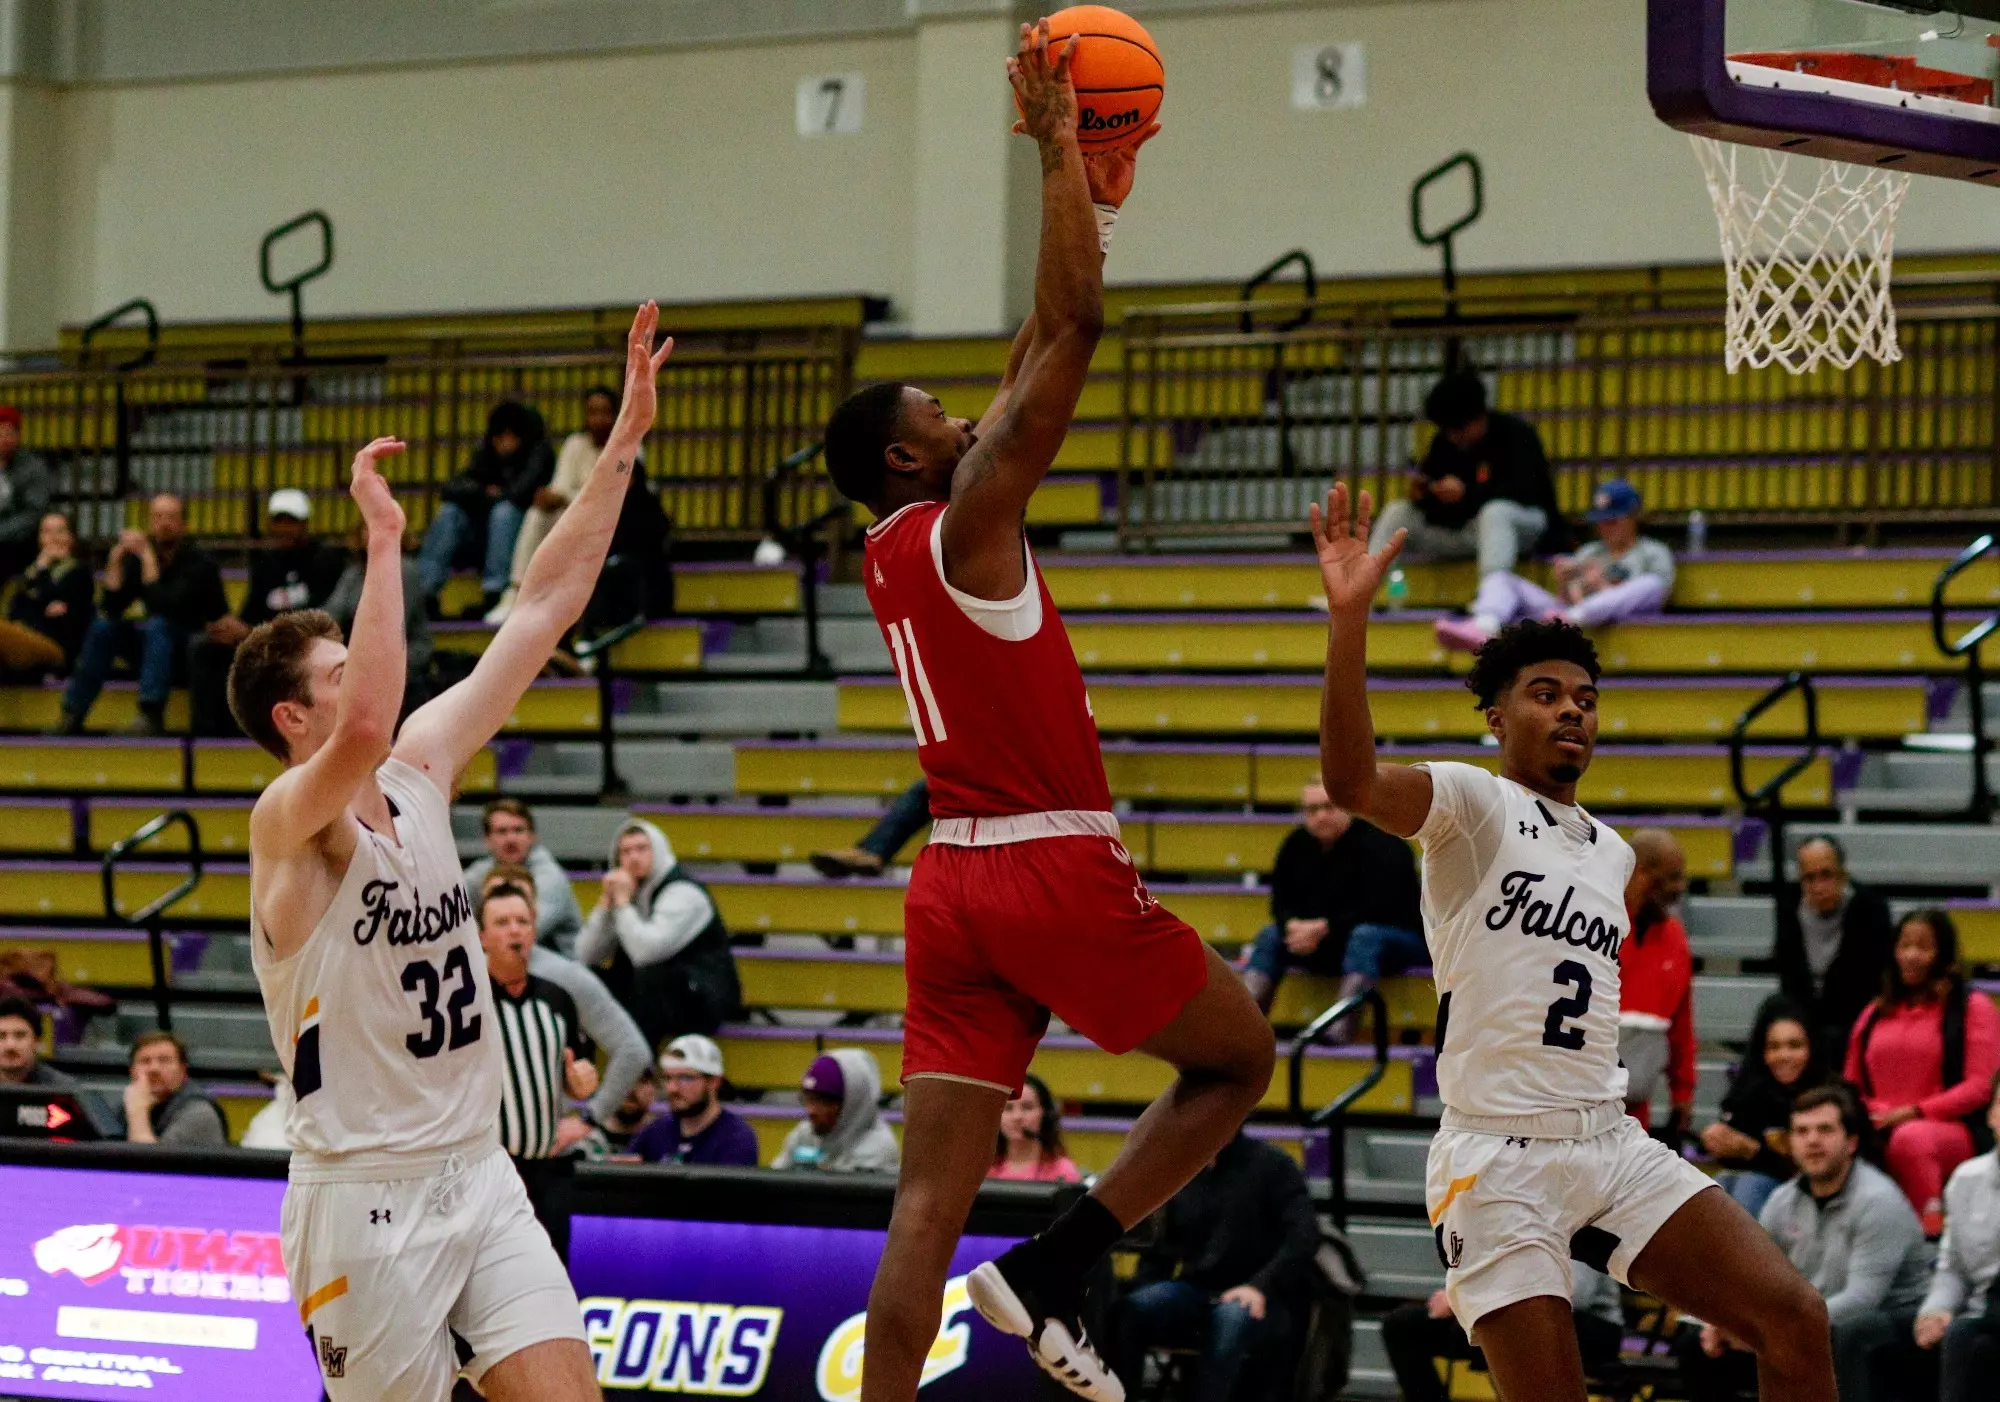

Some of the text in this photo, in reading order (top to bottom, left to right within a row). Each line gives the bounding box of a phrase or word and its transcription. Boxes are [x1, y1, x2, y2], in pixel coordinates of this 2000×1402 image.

[820, 78, 844, 131] 7
[1078, 107, 1139, 130] lson
[1315, 46, 1343, 105] 8
[887, 617, 948, 747] 11
[400, 945, 482, 1059] 32
[1542, 959, 1593, 1050] 2
[579, 1296, 783, 1396] CONS
